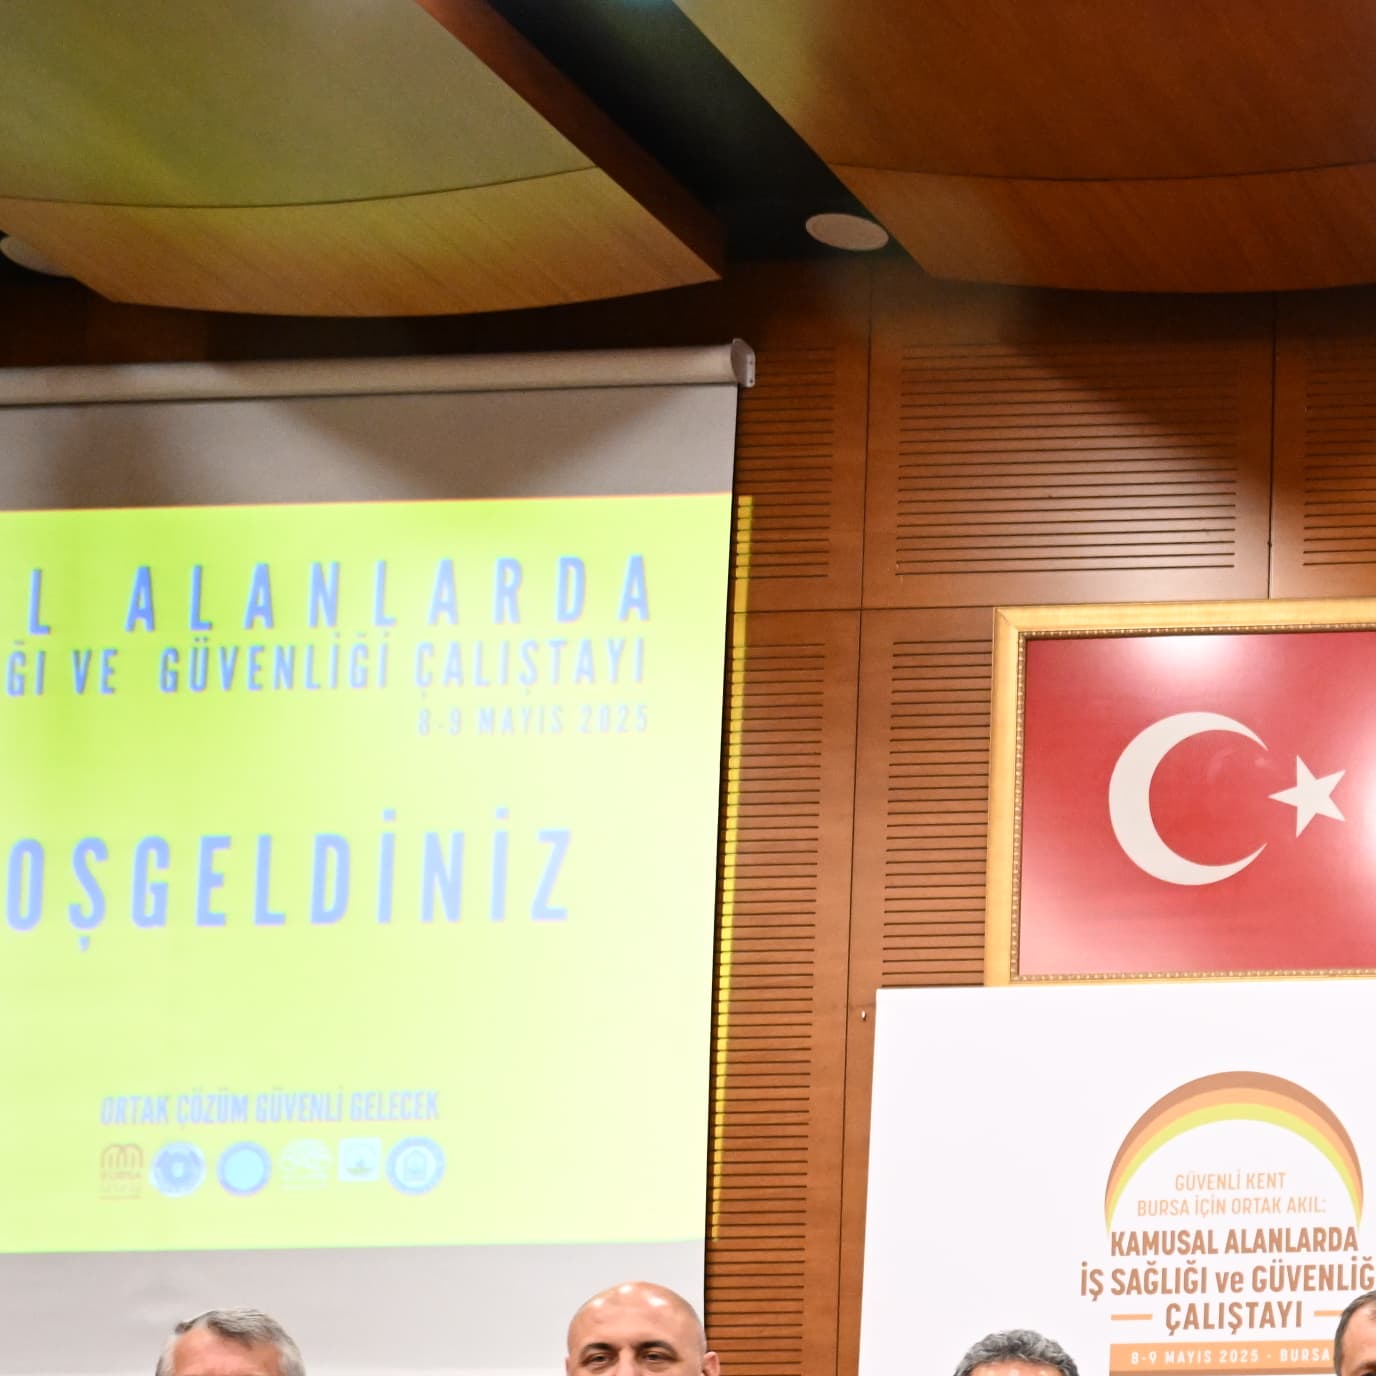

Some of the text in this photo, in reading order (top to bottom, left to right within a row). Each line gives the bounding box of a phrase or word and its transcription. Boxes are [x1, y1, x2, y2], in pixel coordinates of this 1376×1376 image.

[125, 554, 651, 633] ALANLARDA
[72, 648, 118, 695] VE
[159, 631, 390, 693] GÜVENLİĞİ
[415, 637, 646, 698] ÇALIŞTAYI
[417, 702, 649, 737] 8-9 MAYIS 2025
[100, 1085, 440, 1130] ORTAK ÇÖZÜM GÜVENLİ GELECEK
[1175, 1169, 1286, 1192] GÜVENLİ KENT
[1137, 1195, 1327, 1219] BURSA İÇİN ORTAK AKIL:
[1110, 1226, 1359, 1257] KAMUSAL ALANLARDA
[1080, 1261, 1105, 1302] İŞ
[1110, 1260, 1207, 1295] SAĞLIĞI
[1215, 1272, 1244, 1294] ve
[1165, 1300, 1303, 1335] ÇALIŞTAYI
[1130, 1347, 1330, 1365] 8-9 MAYIS 2025 BURSA
